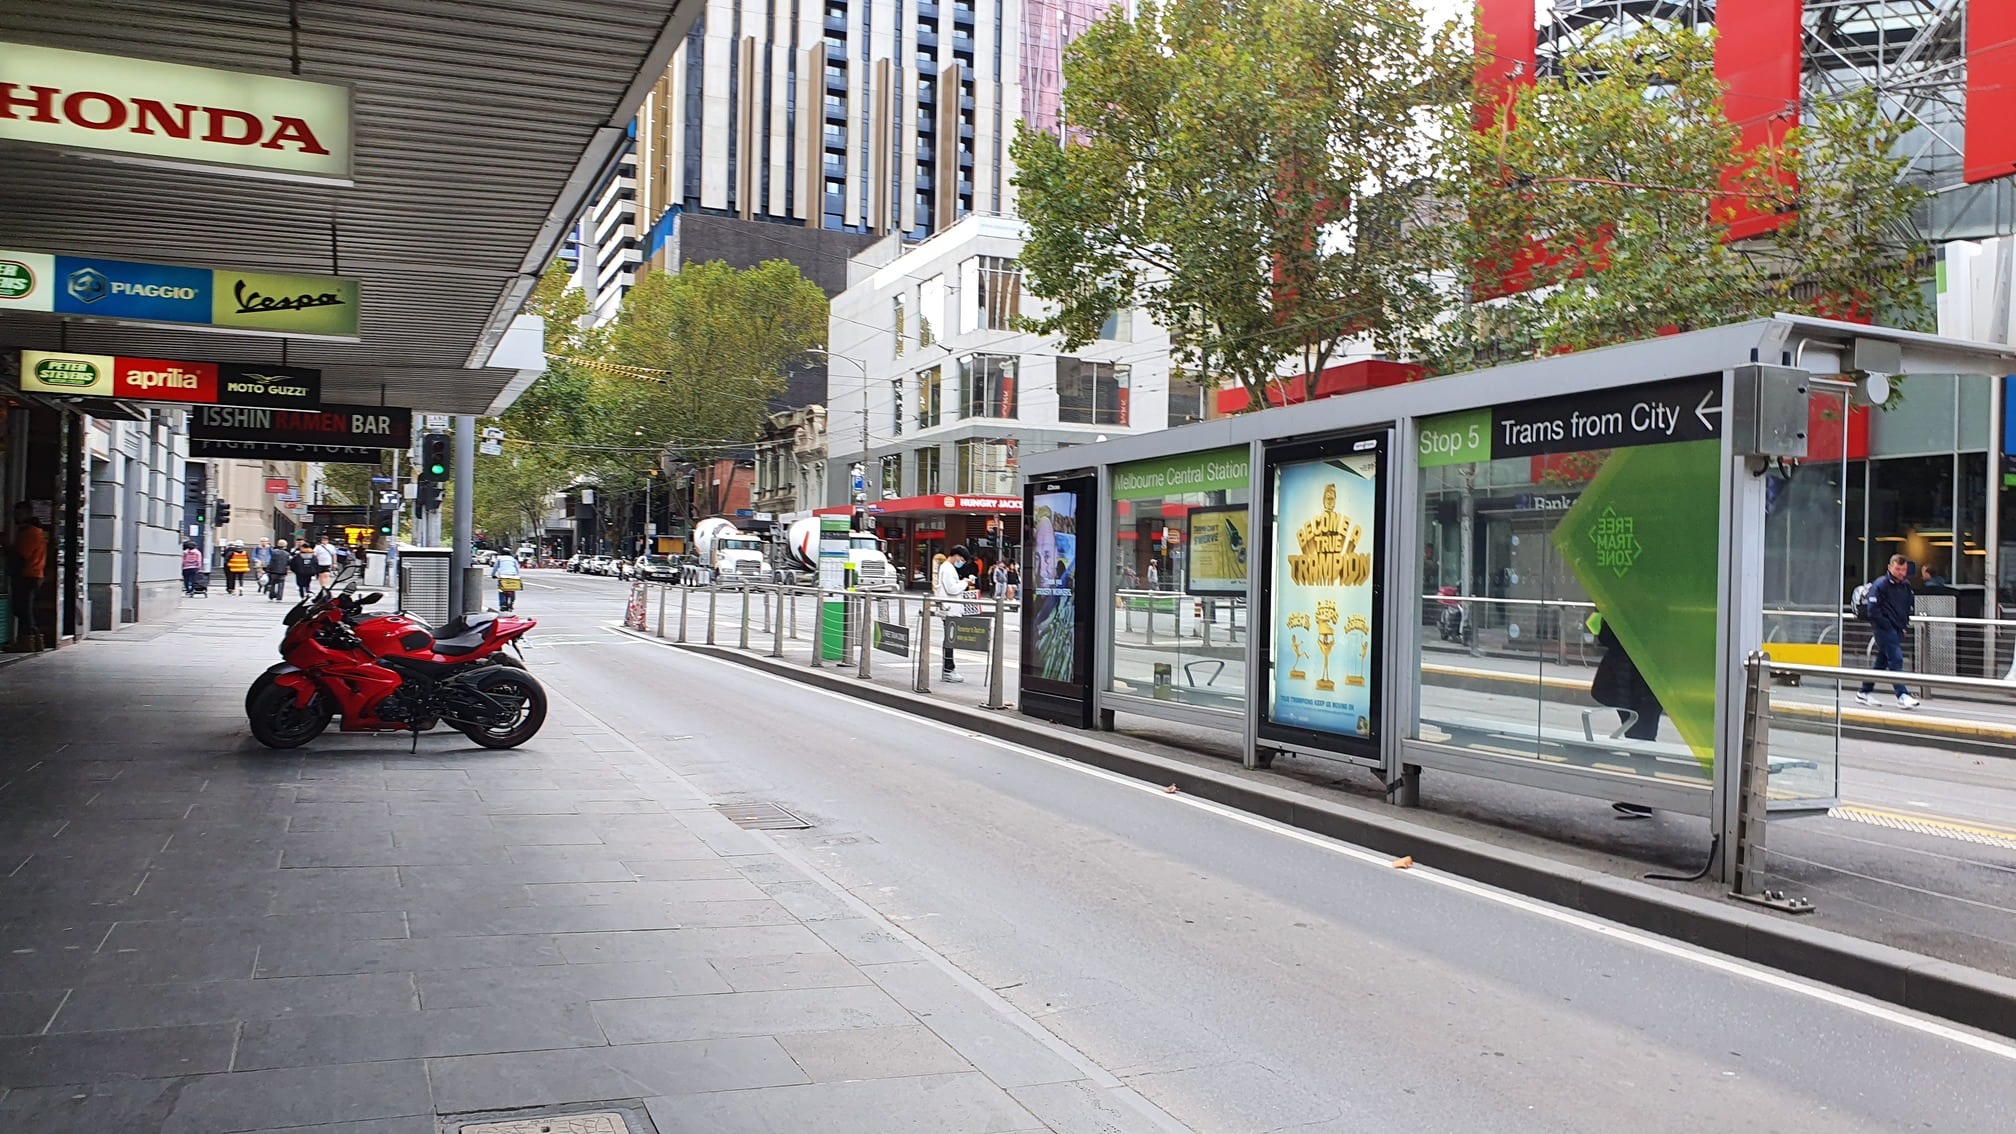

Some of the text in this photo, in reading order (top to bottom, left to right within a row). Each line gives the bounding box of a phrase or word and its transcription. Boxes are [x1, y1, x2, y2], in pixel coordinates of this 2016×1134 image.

[0, 82, 330, 156] HONDA
[110, 281, 195, 300] PIAGGIO
[234, 279, 346, 313] Vespa
[39, 369, 94, 381] STEVENS
[47, 361, 88, 371] PETER
[126, 367, 198, 389] aprilia
[227, 382, 307, 396] MOTO GUZZI
[203, 406, 391, 435] ISSHIN RAMEN BAR
[1501, 402, 1680, 445] Trams from City
[1420, 425, 1480, 456] Stop 5
[1114, 460, 1248, 490] Melbourne Central Station
[960, 498, 997, 508] HUNGRY
[1534, 496, 1571, 510] Bank
[1296, 510, 1350, 548] BECOME
[1314, 535, 1342, 552] TRUE
[1287, 552, 1371, 586] TRAMPION
